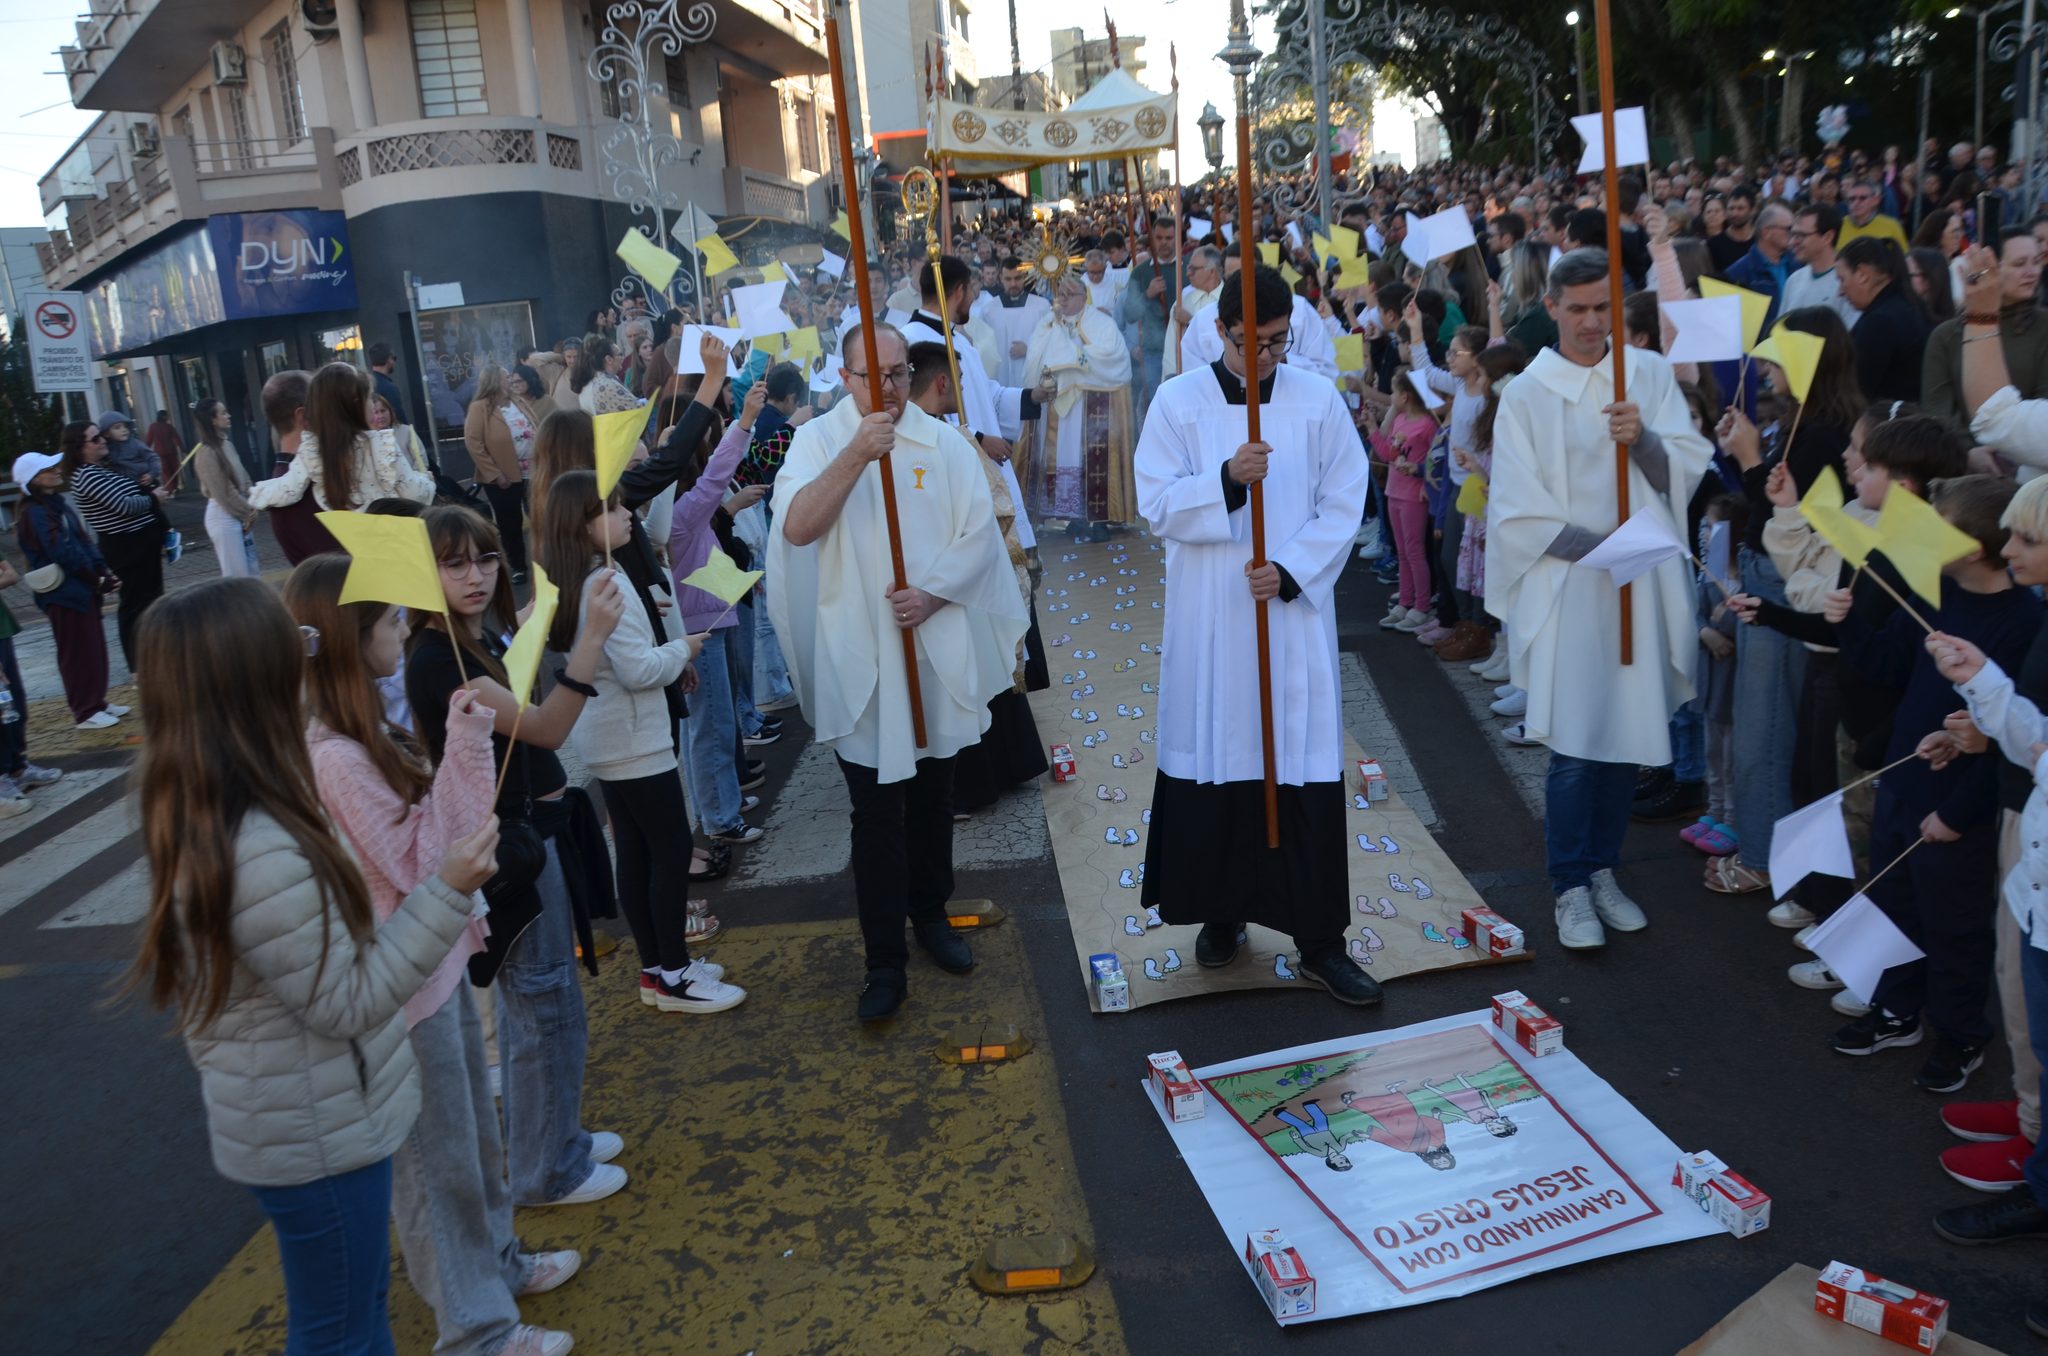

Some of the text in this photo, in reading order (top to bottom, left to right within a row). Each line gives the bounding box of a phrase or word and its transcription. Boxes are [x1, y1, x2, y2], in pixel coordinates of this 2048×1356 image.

[38, 355, 73, 363] TRÂNSITO
[41, 364, 84, 373] CAMINHÕES
[443, 366, 477, 382] ESPO
[1373, 1165, 1594, 1249] JESUS CRISTO
[1398, 1189, 1628, 1273] CAMINHANDO COM
